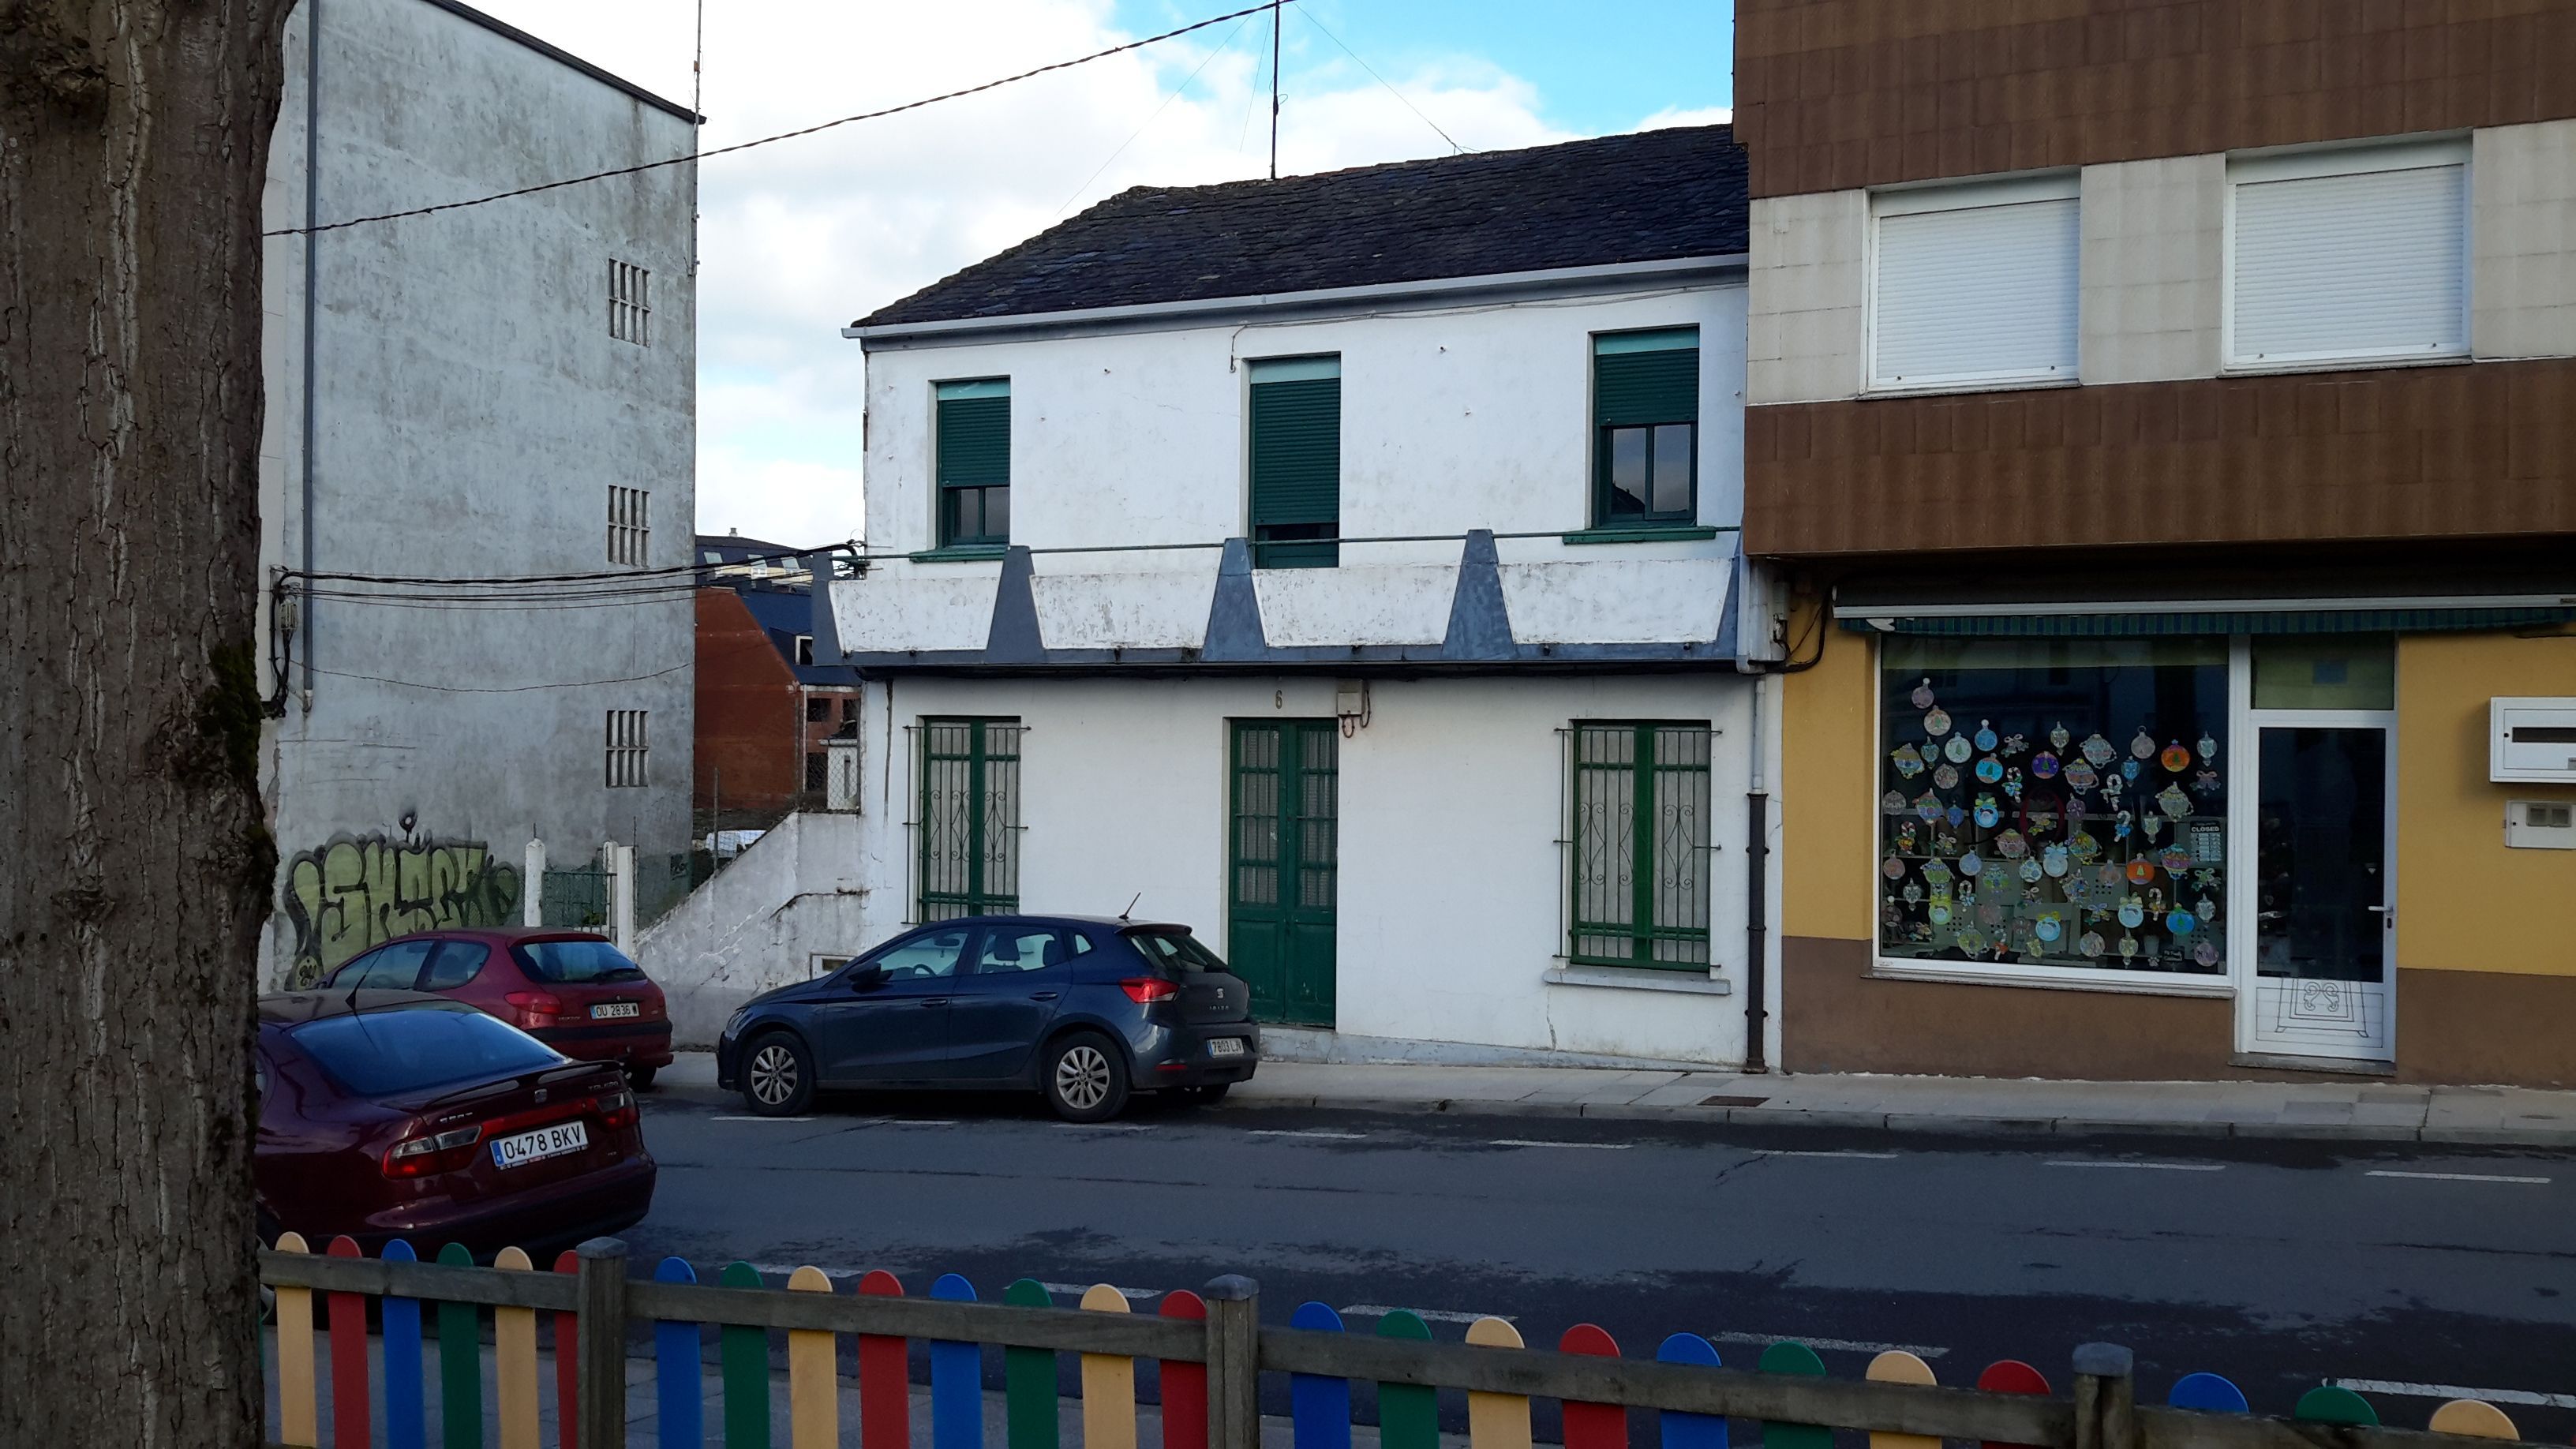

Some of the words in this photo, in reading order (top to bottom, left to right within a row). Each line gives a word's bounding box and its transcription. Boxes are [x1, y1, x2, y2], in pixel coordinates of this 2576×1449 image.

[1275, 690, 1282, 709] 6
[504, 1133, 548, 1159] 0478
[551, 1125, 581, 1148] BKV
